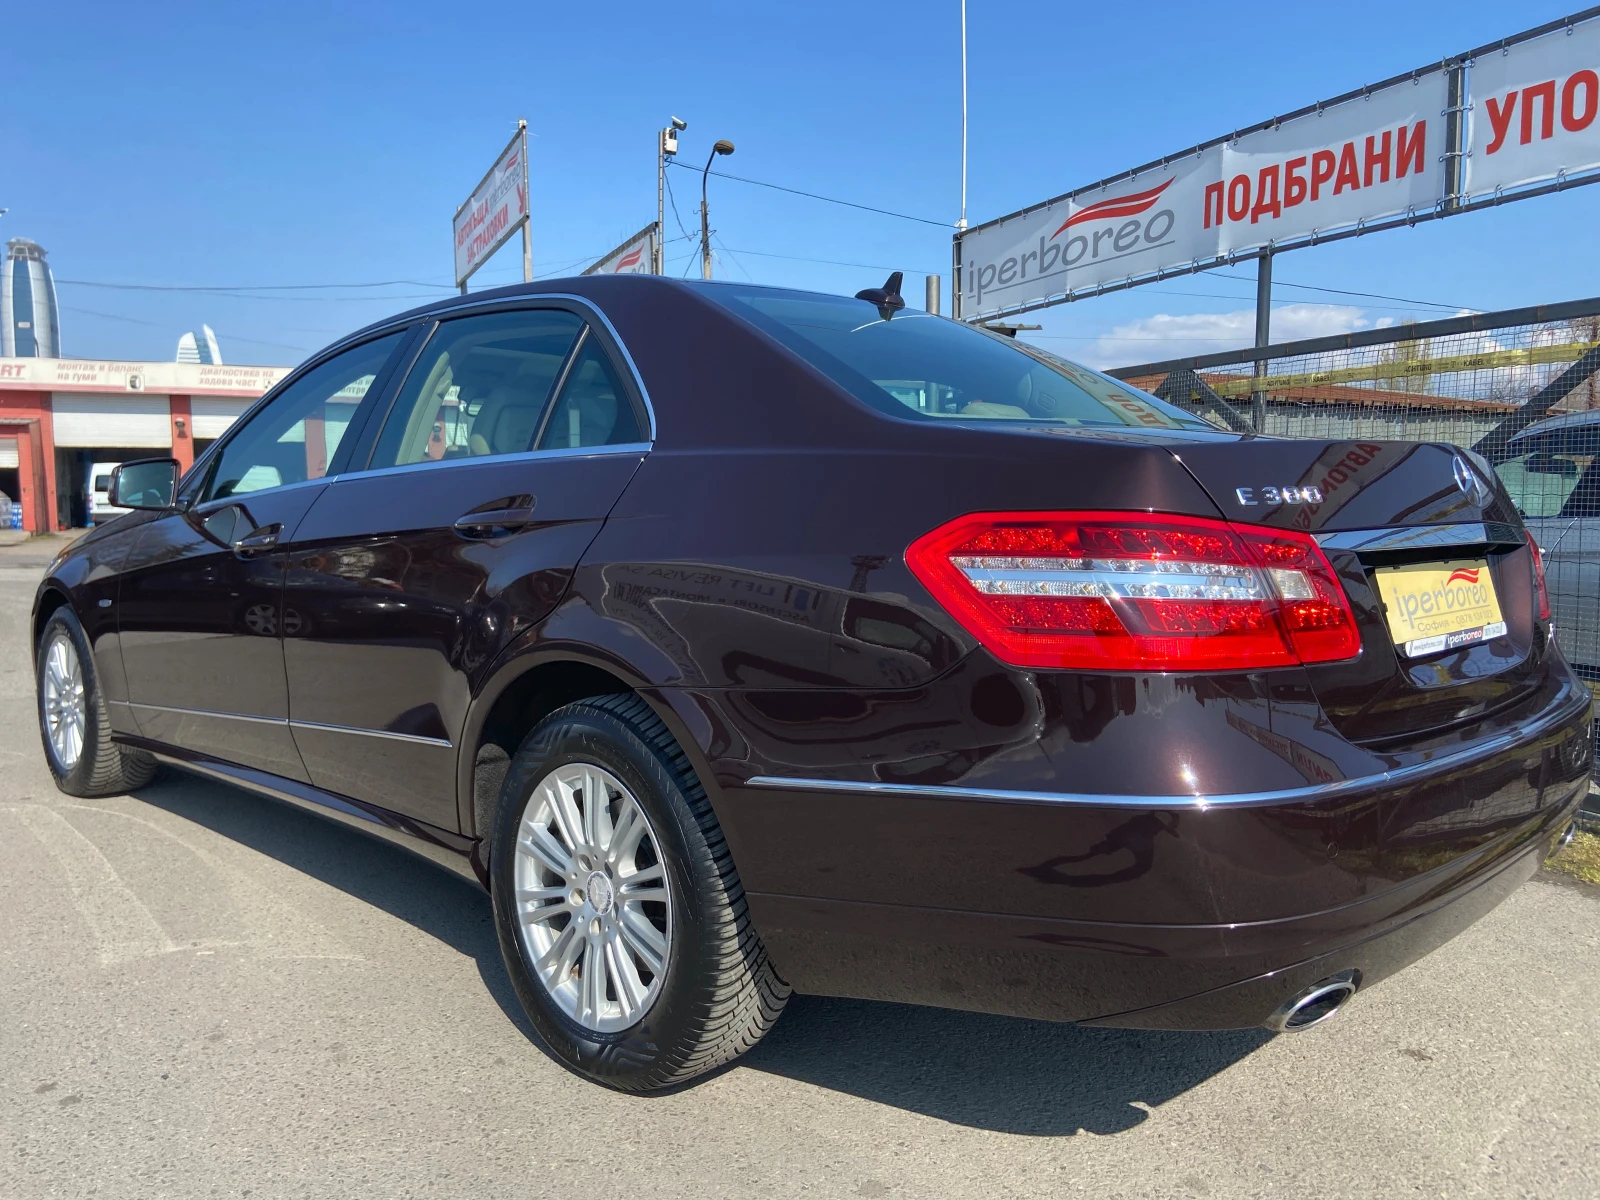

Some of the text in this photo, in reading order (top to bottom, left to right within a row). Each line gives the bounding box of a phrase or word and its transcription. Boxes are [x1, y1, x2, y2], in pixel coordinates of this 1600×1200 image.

[1203, 119, 1427, 230] ПОДБРАНИ
[968, 208, 1175, 306] iperboreo
[57, 363, 144, 373] монтаж и баланс
[200, 367, 274, 378] диагностика на
[57, 373, 97, 382] на гуми
[199, 377, 257, 388] ходова част
[1234, 485, 1323, 506] E 300
[1393, 580, 1488, 630] iperboreo
[1417, 620, 1450, 633] София
[1447, 628, 1483, 649] iperboreo
